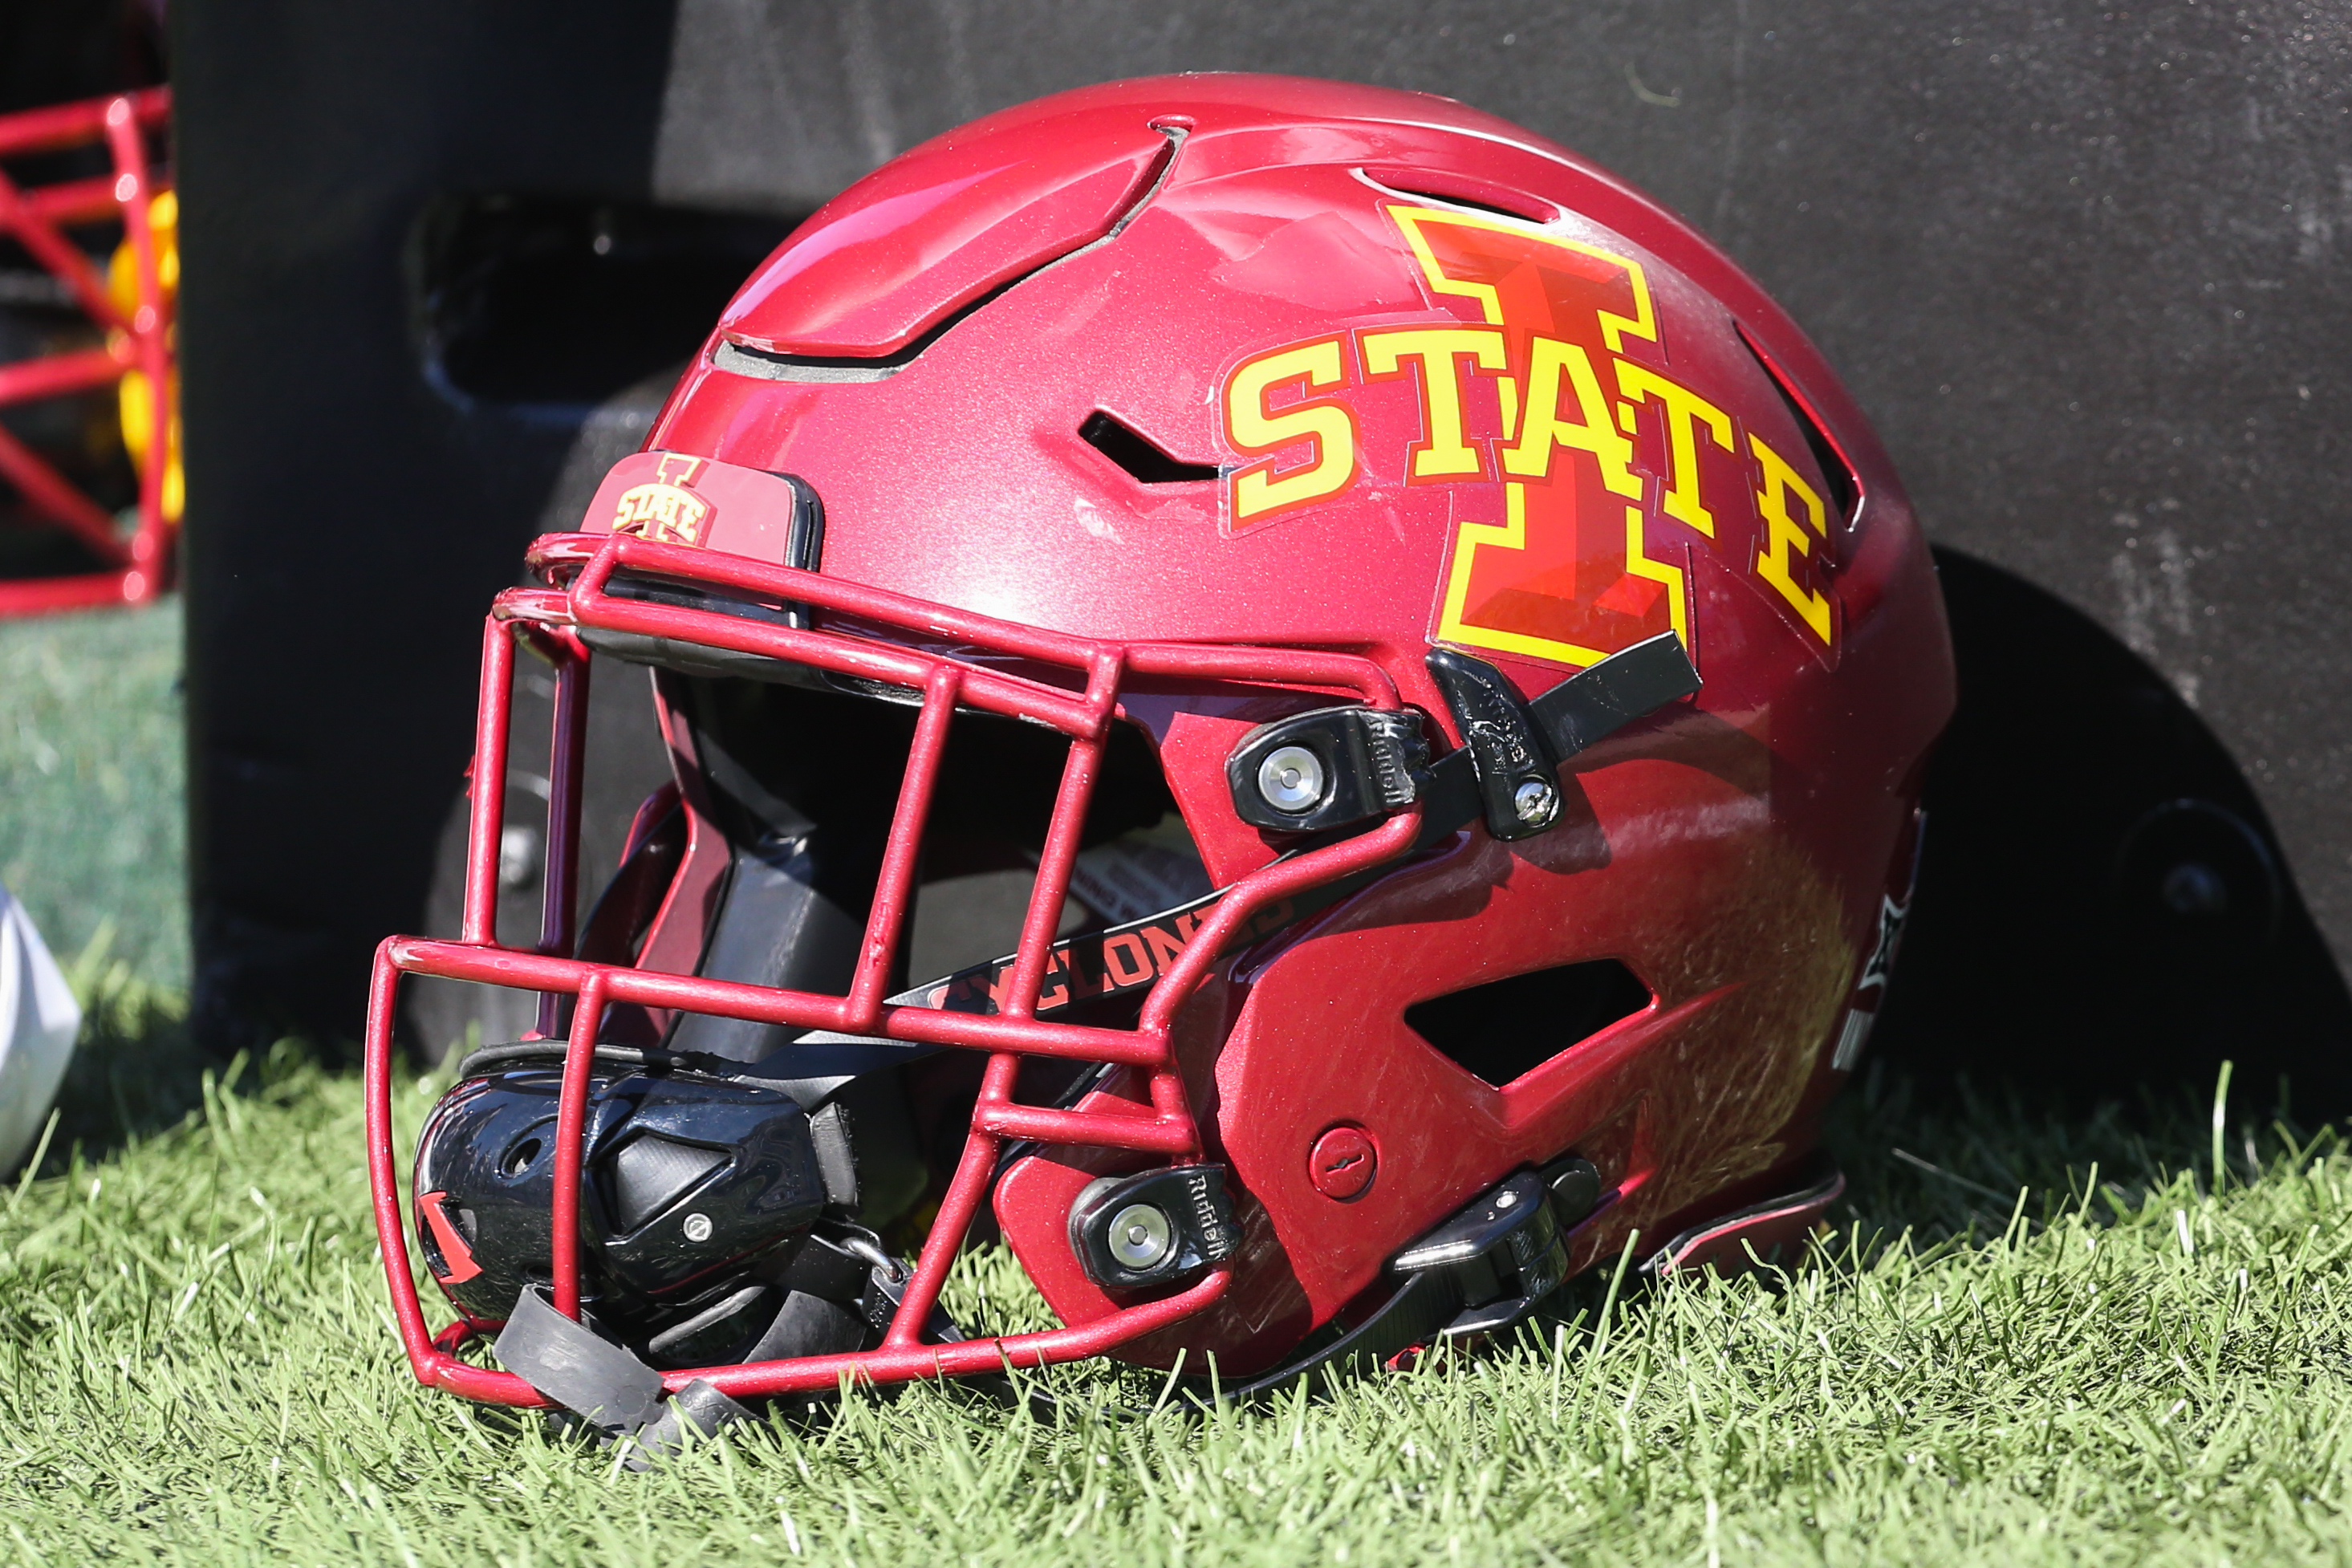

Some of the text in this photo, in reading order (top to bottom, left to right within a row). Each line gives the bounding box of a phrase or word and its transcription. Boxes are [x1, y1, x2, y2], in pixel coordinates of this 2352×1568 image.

[612, 483, 707, 543] STATE
[1226, 327, 1833, 648] STATE
[1188, 1175, 1226, 1261] Riddell
